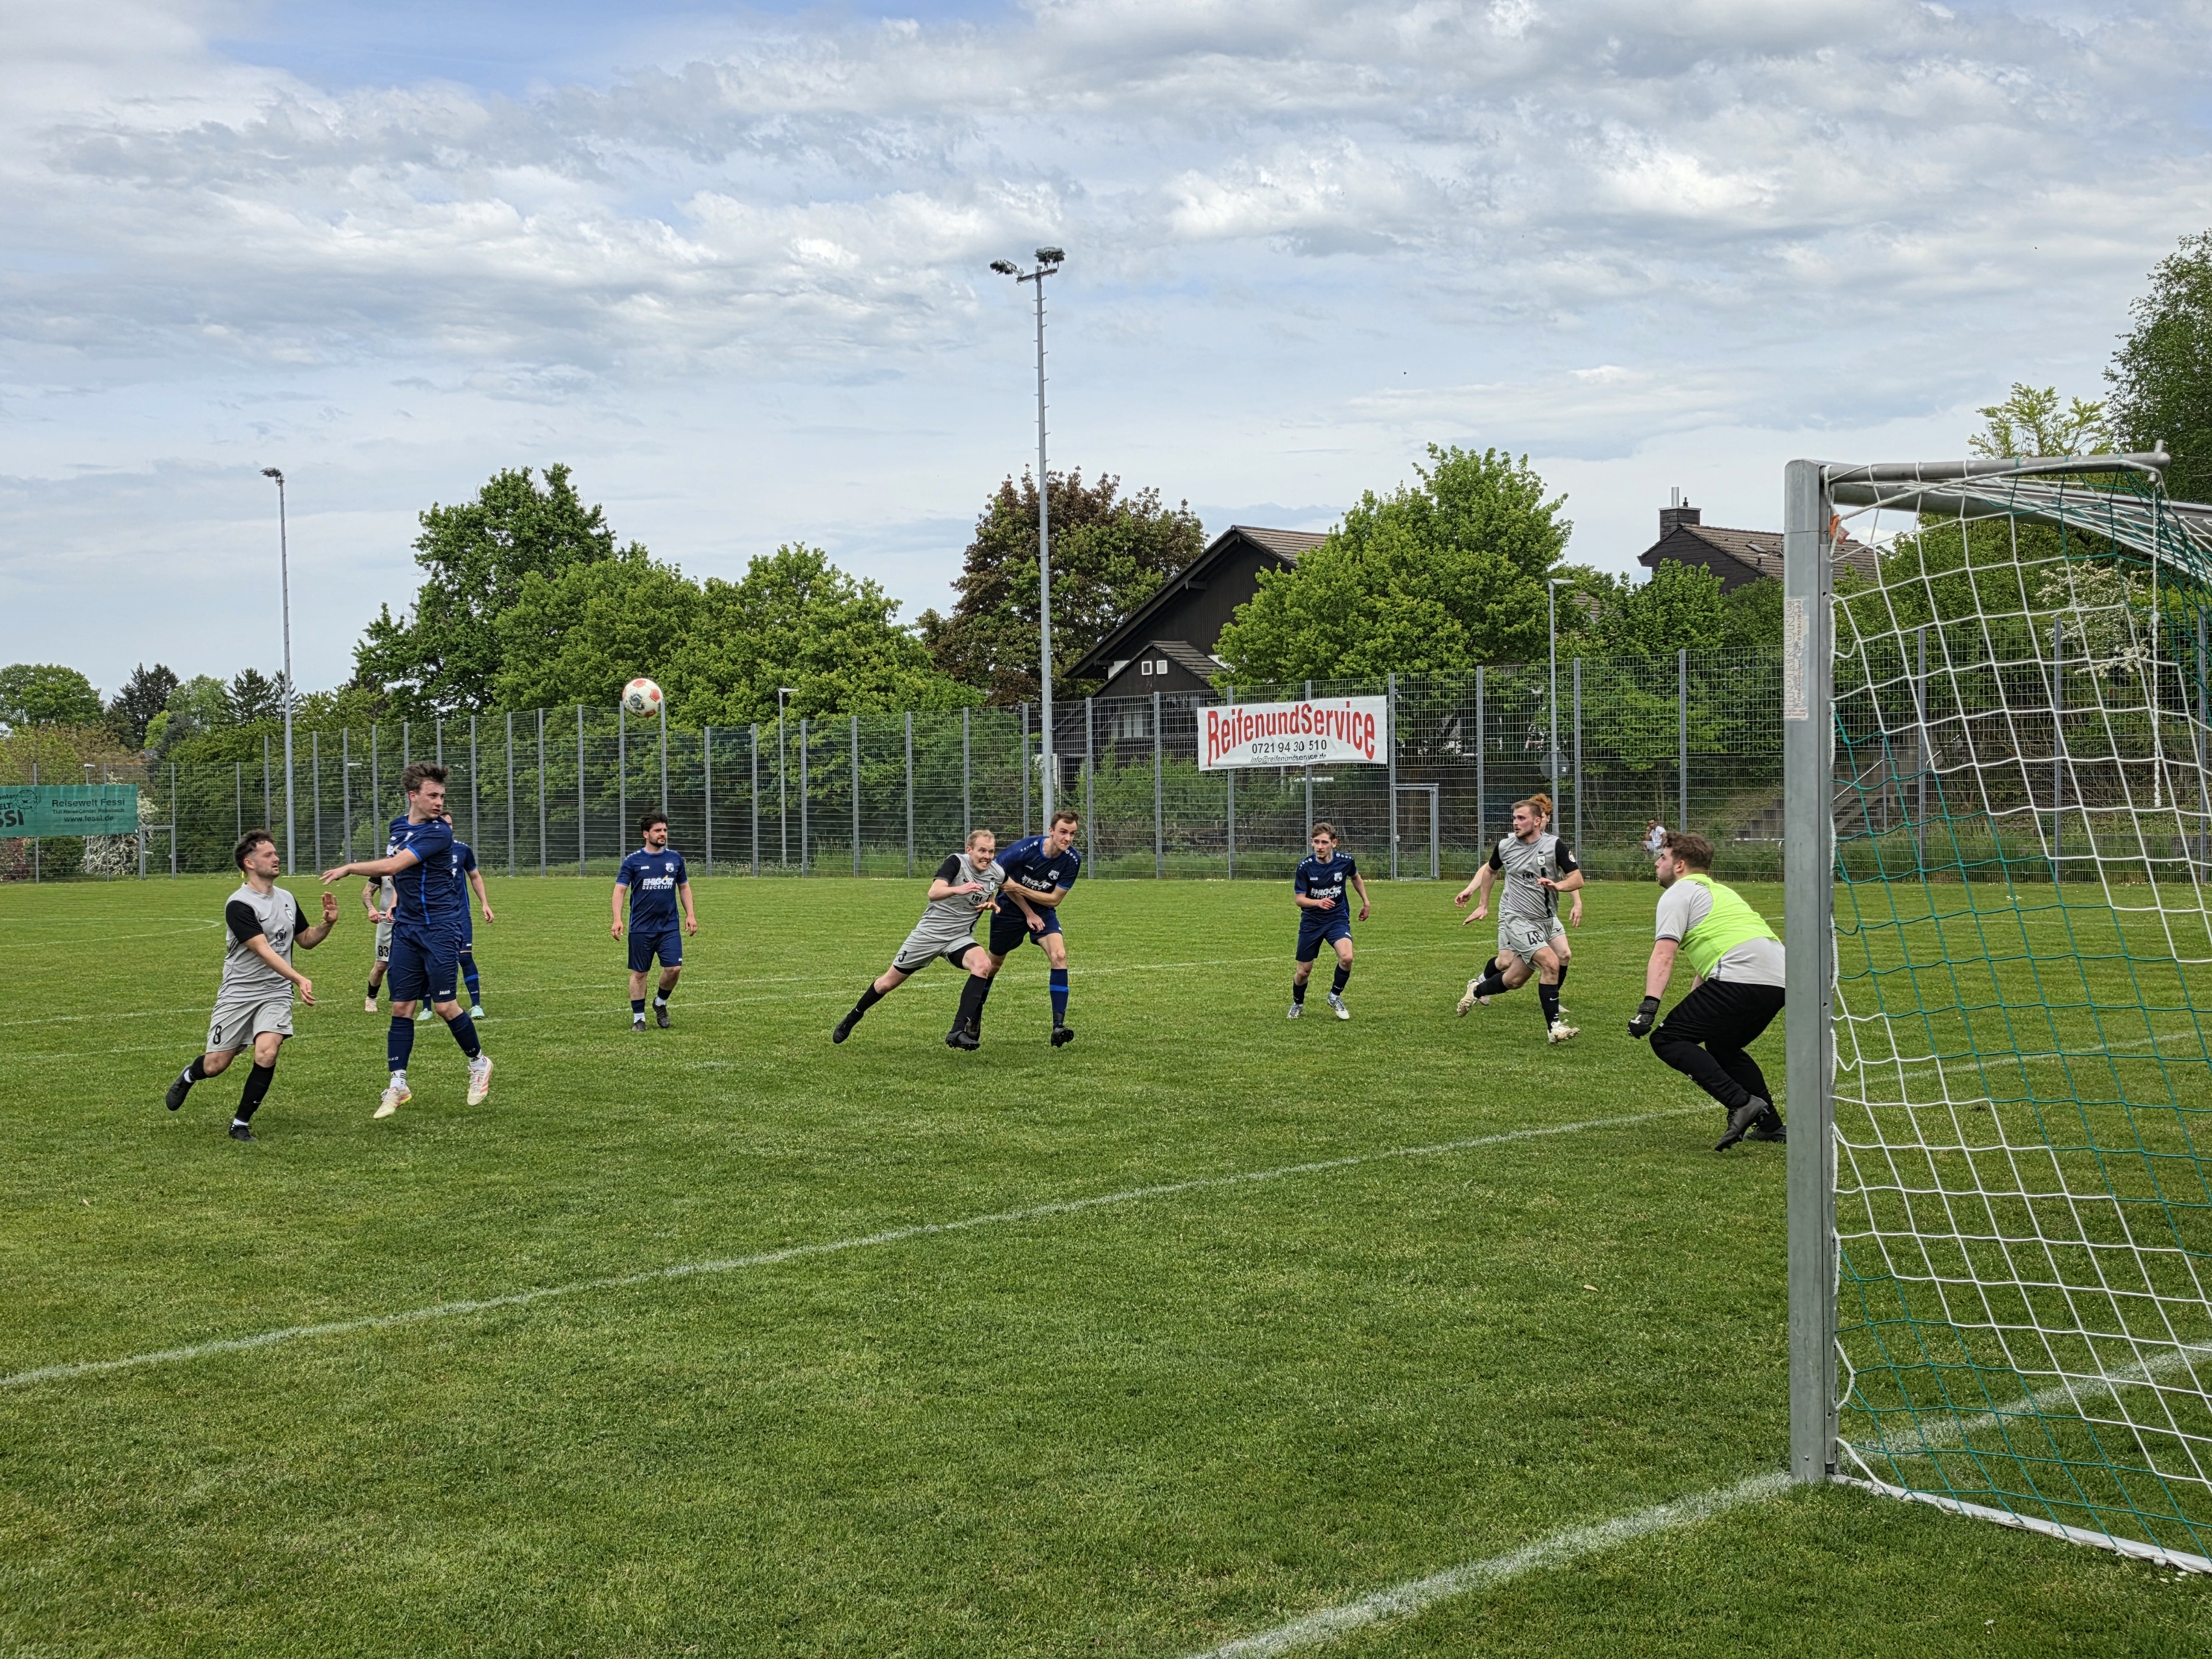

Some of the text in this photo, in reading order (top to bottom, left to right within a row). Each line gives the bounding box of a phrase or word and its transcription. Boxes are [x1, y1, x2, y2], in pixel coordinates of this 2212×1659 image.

[1207, 701, 1375, 768] ReifenundService
[1252, 739, 1327, 754] 0721 94 30 510
[1251, 753, 1327, 764] info@reifenundservice.de
[52, 799, 98, 807] Reisewelt
[1527, 931, 1544, 945] 48
[378, 945, 389, 957] 83
[213, 1025, 222, 1045] 8
